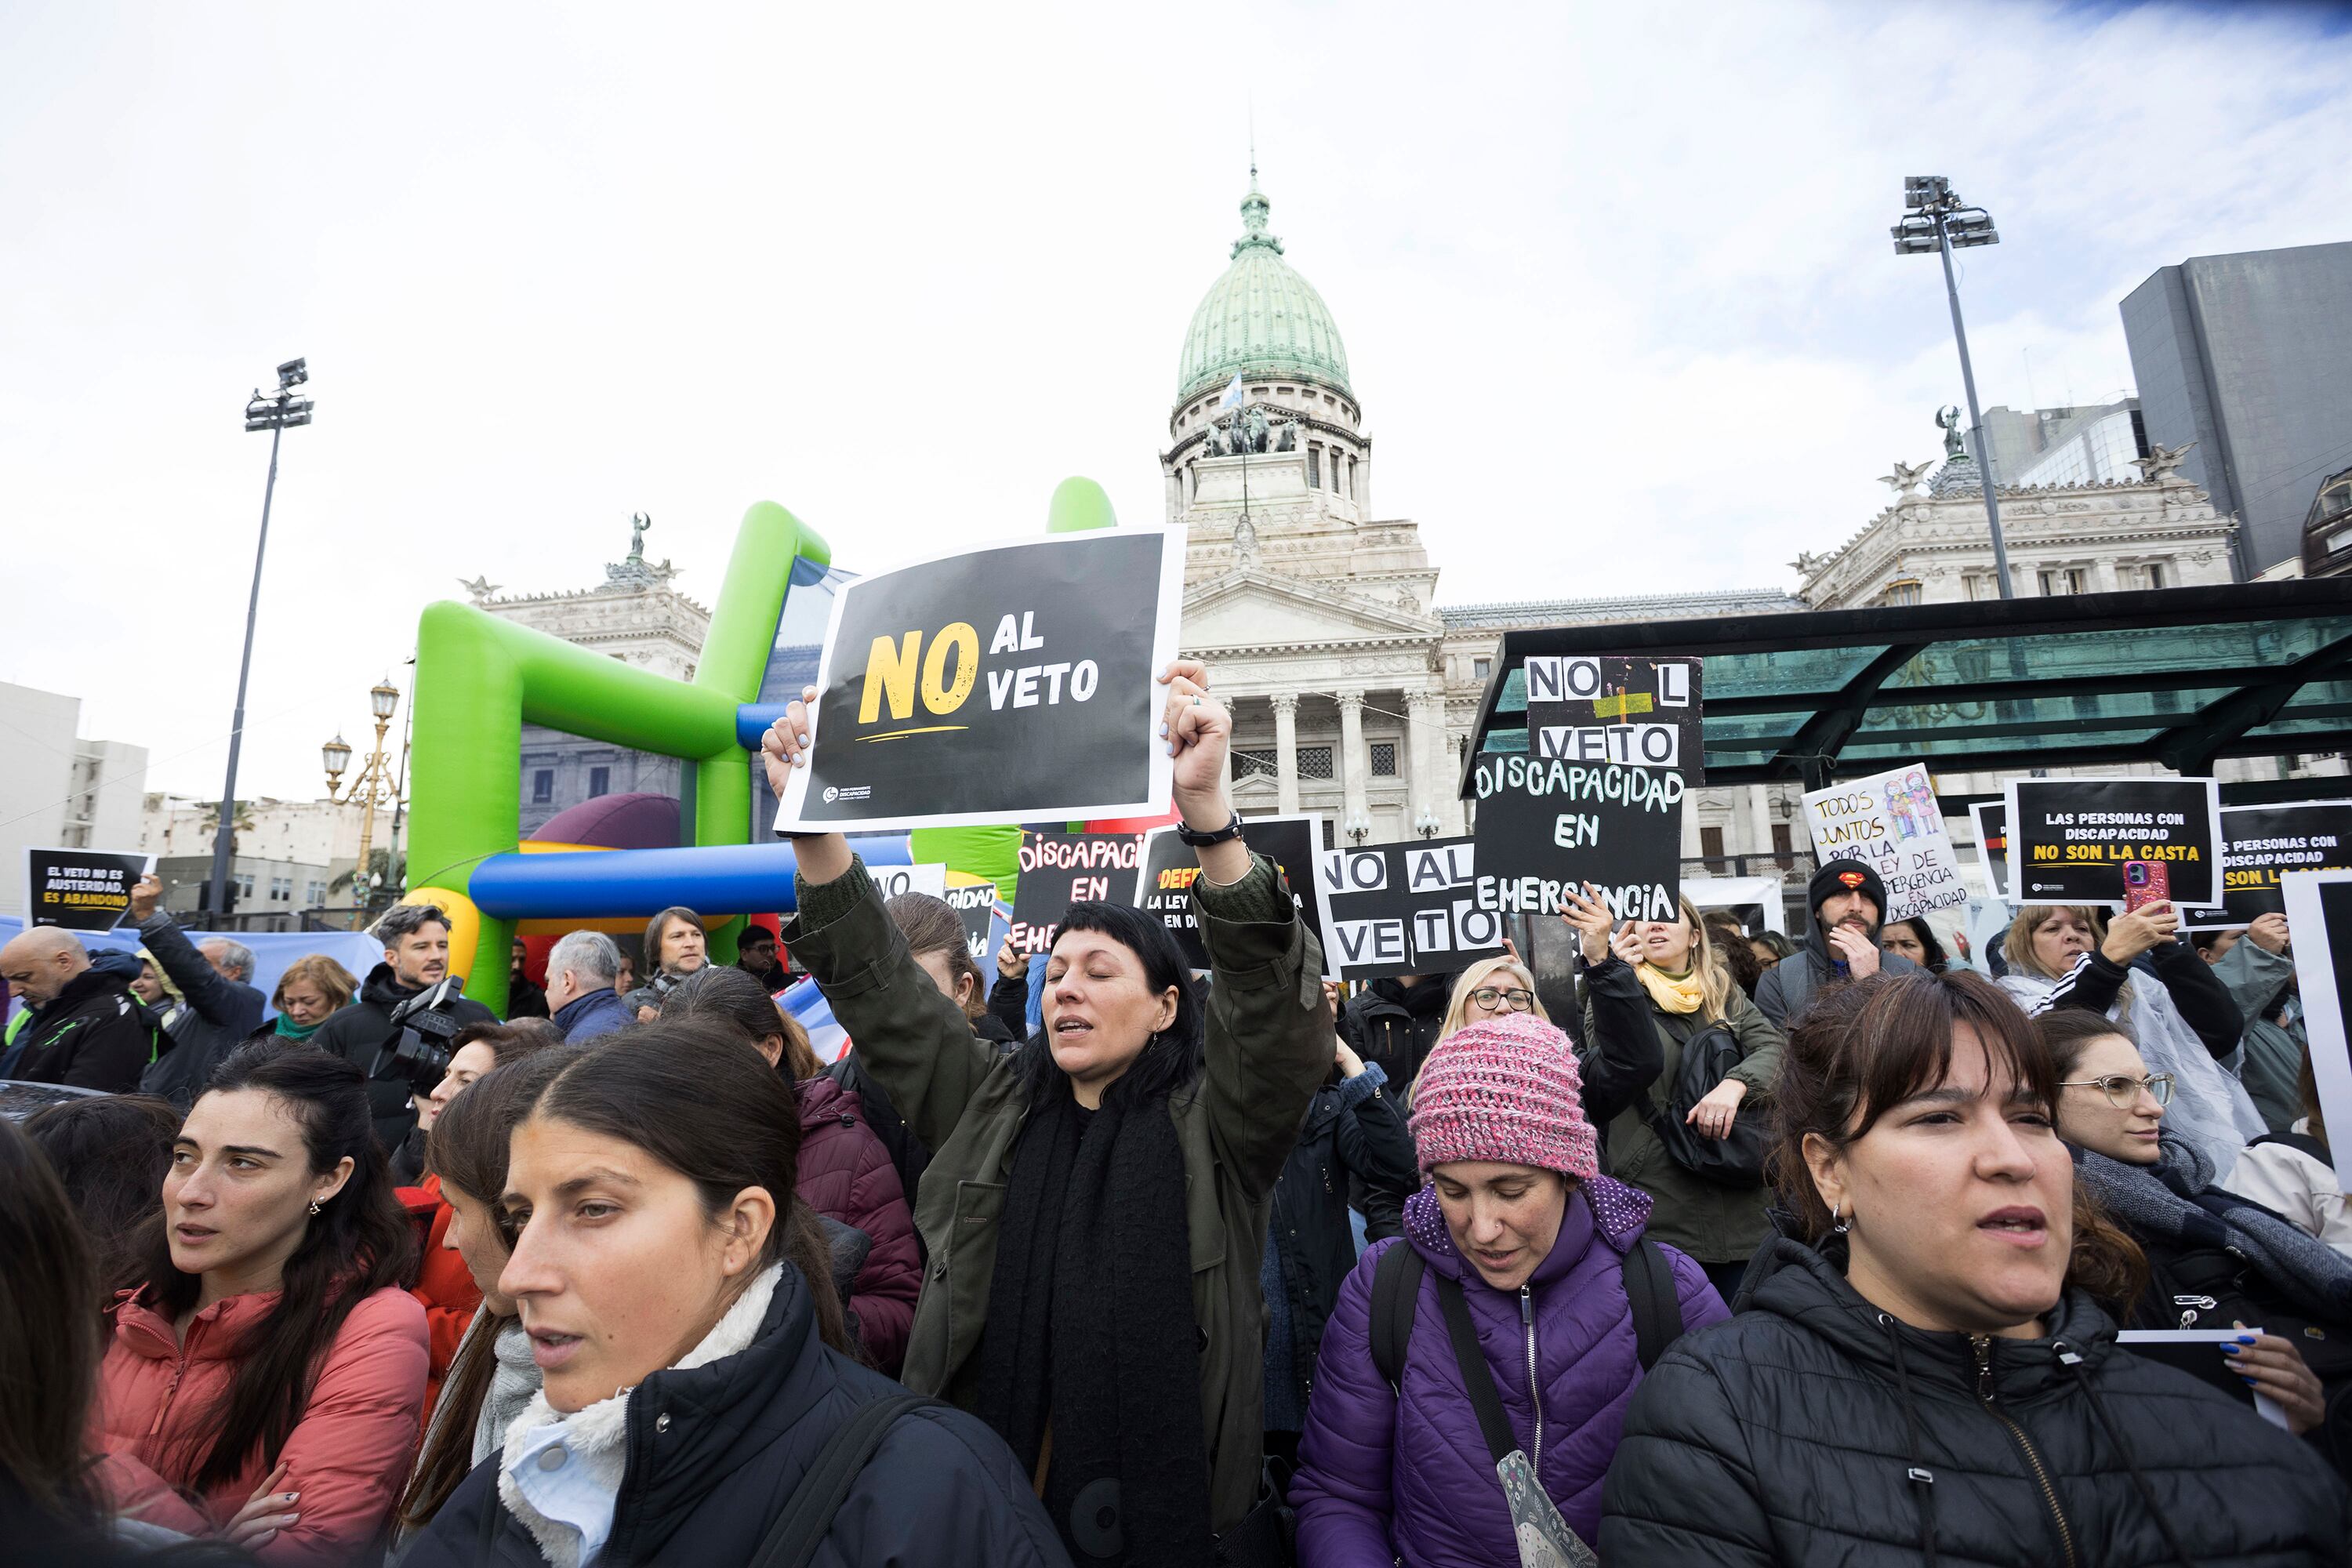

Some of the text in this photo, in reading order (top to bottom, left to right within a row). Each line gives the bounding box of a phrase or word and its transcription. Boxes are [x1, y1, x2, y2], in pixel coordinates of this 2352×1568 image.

[858, 611, 1044, 724] NO AL
[987, 659, 1098, 711] VETO
[1530, 660, 1600, 696] NO
[1541, 726, 1673, 763] VETO
[1475, 756, 1685, 813] DISCAPACIDAD
[1815, 791, 1873, 818] TODOS
[2046, 813, 2184, 825] LAS PERSONAS CON
[1554, 813, 1599, 848] EN
[1819, 817, 1885, 846] JUNTOS
[2065, 828, 2169, 840] DISCAPACIDAD
[1829, 840, 1895, 860] POR LA
[2034, 844, 2199, 861] NO SON LA CASTA
[2233, 837, 2307, 852] PERSONAS
[2310, 836, 2337, 848] CON
[1913, 849, 1937, 869] DE
[2223, 851, 2324, 868] DISCAPACIDAD
[47, 866, 124, 880] EL VETO NO ES
[1325, 853, 1385, 890] NO
[1412, 849, 1473, 887] AL
[2225, 869, 2263, 886] SON
[46, 879, 125, 894] AUSTERIDAD,
[1071, 877, 1109, 902] EN
[1882, 867, 1954, 895] MERGENCIA
[43, 892, 129, 906] ES ABANDONO
[1147, 895, 1189, 909] LA LEY
[1890, 888, 1966, 921] DISCAPACIDAD
[1908, 890, 1926, 902] EN
[1164, 914, 1182, 929] EN
[1335, 909, 1497, 961] VETO
